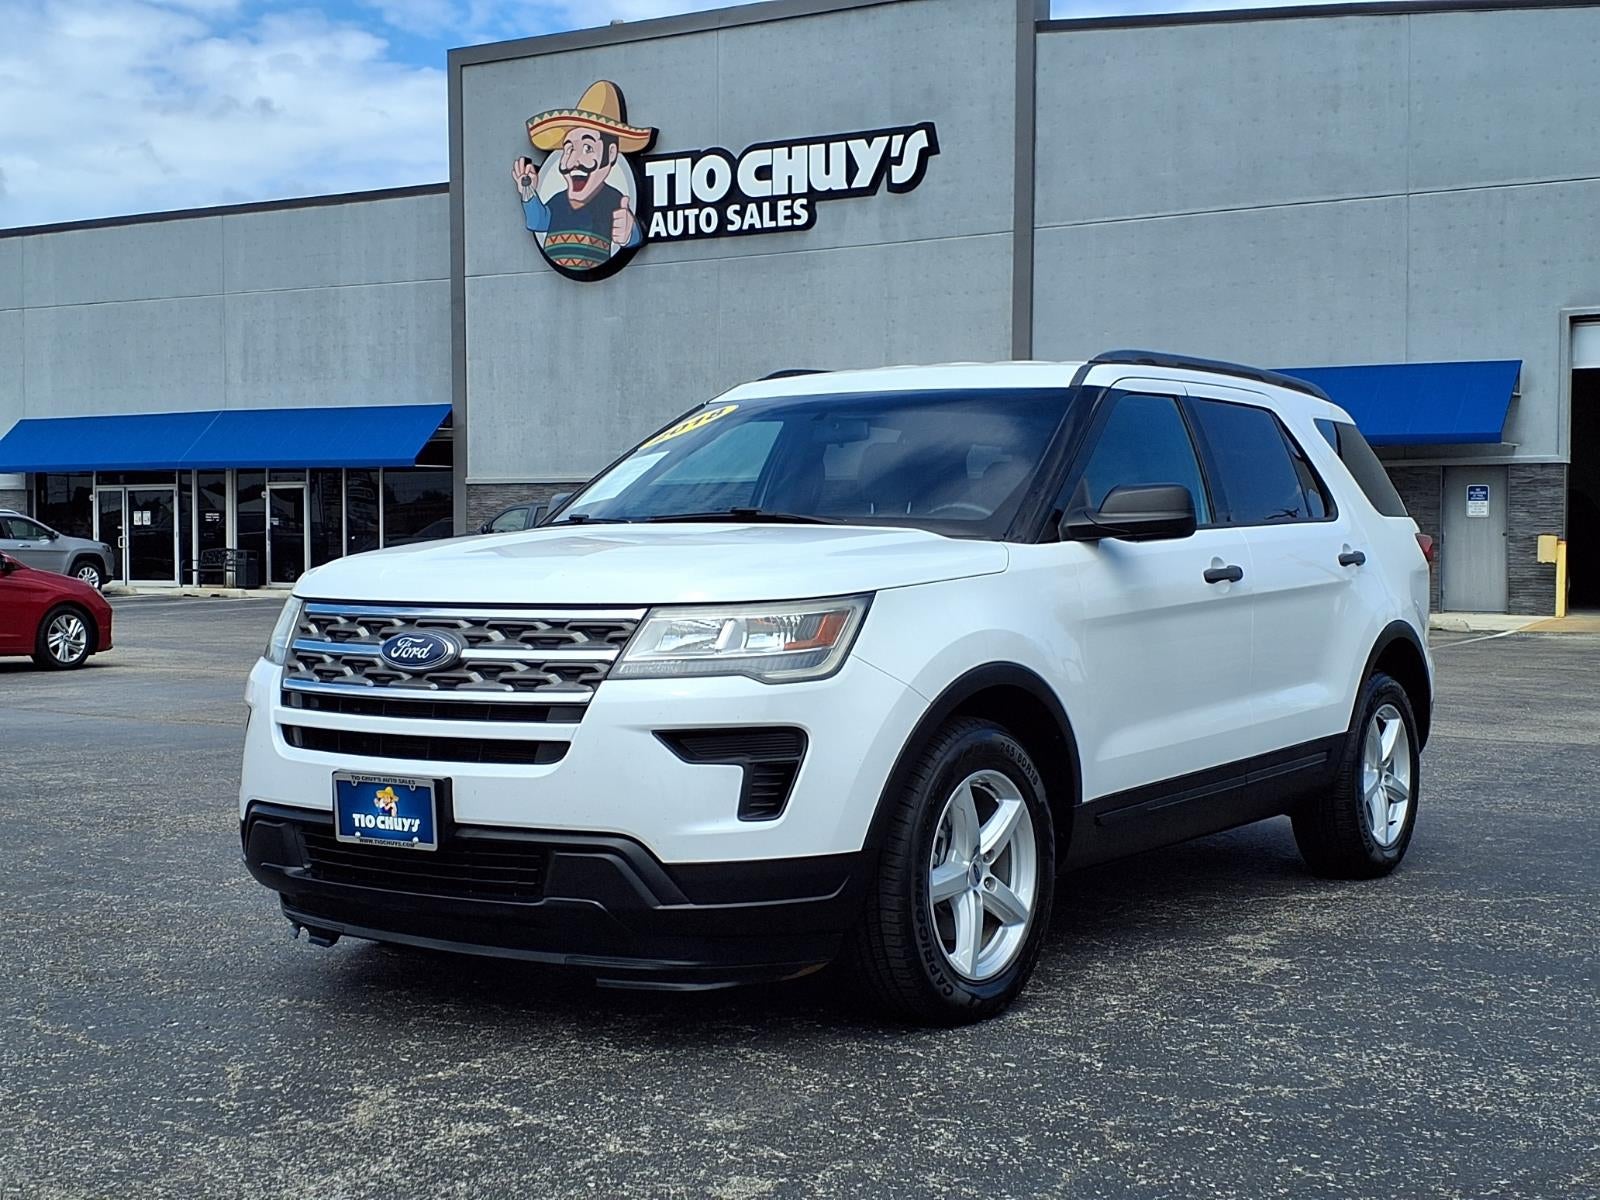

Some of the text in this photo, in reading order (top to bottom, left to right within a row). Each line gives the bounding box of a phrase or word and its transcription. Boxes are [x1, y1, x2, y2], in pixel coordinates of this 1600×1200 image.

[645, 129, 929, 207] TIO CHUY'S
[648, 198, 809, 240] AUTO SALES
[390, 637, 434, 659] Ford
[398, 778, 416, 786] SALES
[352, 813, 421, 833] TIO CHUY'S
